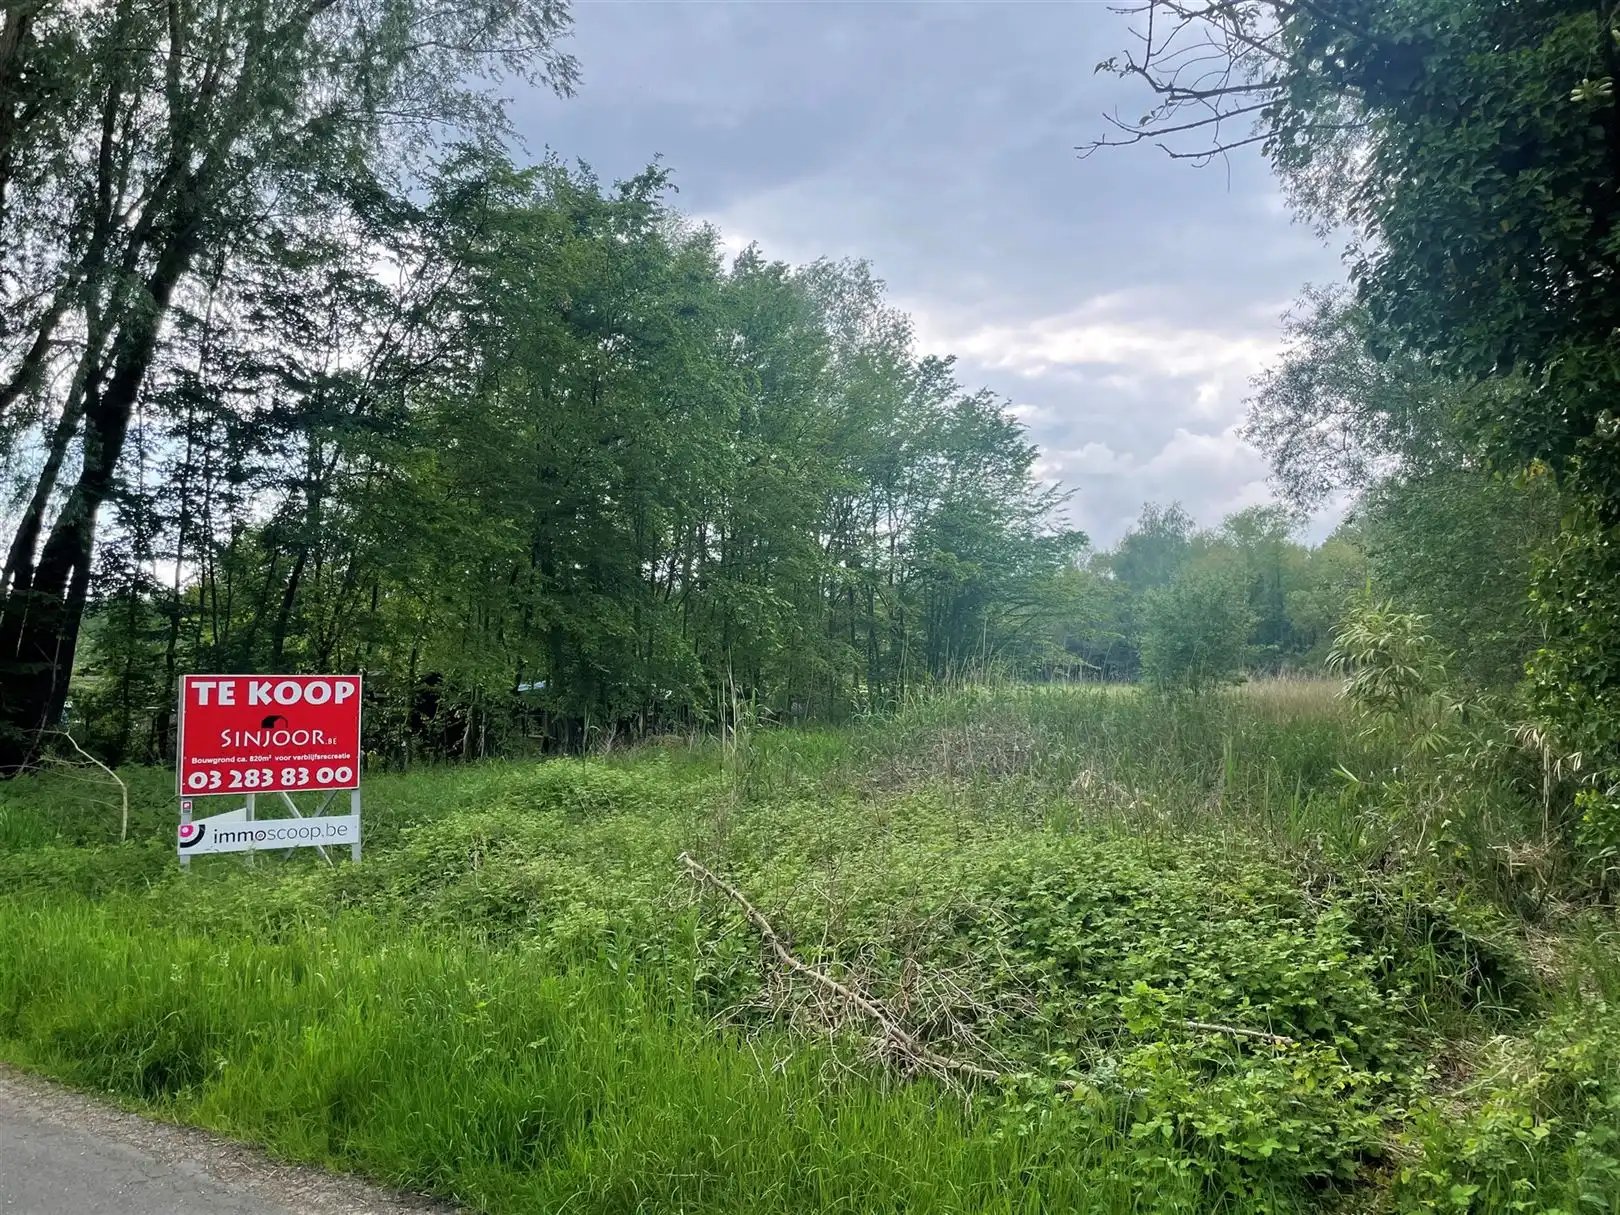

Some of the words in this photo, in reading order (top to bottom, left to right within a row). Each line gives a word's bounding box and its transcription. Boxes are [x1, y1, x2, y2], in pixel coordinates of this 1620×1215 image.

[191, 681, 236, 706] TE
[248, 681, 355, 706] KOOP
[221, 729, 337, 747] SINJOOR.BE
[191, 756, 236, 765] Bouwgrond
[292, 753, 351, 762] verblijfsrecreatie
[188, 770, 222, 790] 03
[228, 768, 274, 788] 283
[281, 767, 309, 786] 83
[316, 766, 353, 784] 00
[213, 823, 348, 844] immoscoop.be
